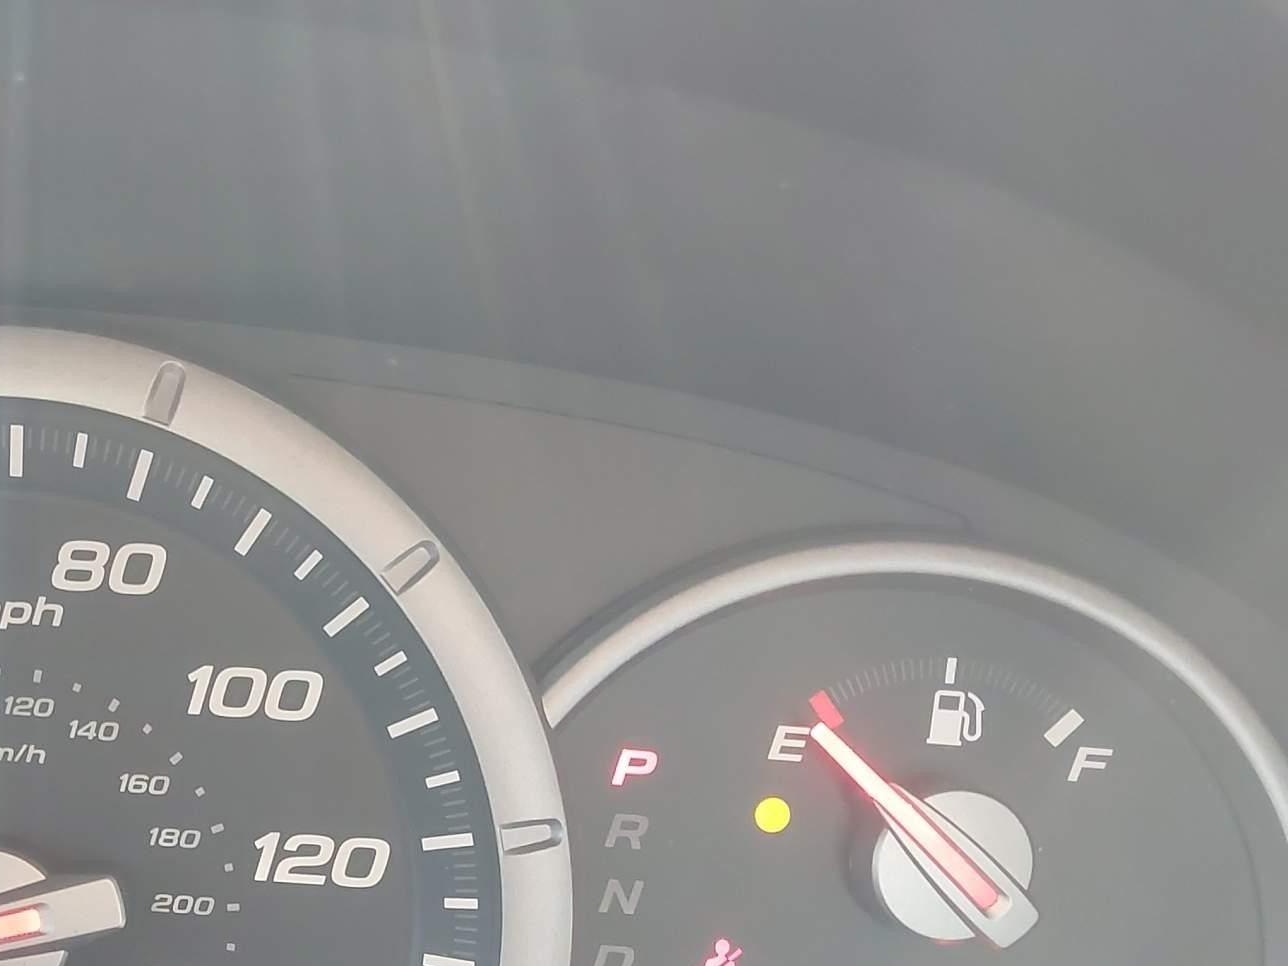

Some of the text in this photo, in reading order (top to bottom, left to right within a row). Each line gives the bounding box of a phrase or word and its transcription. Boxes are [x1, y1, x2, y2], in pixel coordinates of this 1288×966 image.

[52, 541, 166, 594] 80
[5, 696, 54, 717] 120
[188, 666, 323, 721] 100
[70, 720, 119, 740] 140
[768, 726, 811, 761] E
[612, 749, 657, 785] P
[1068, 747, 1113, 781] F
[120, 774, 169, 794] 160
[150, 828, 200, 848] 180
[605, 814, 648, 849] R
[255, 832, 390, 887] 120
[151, 894, 214, 915] 200
[599, 879, 644, 914] N
